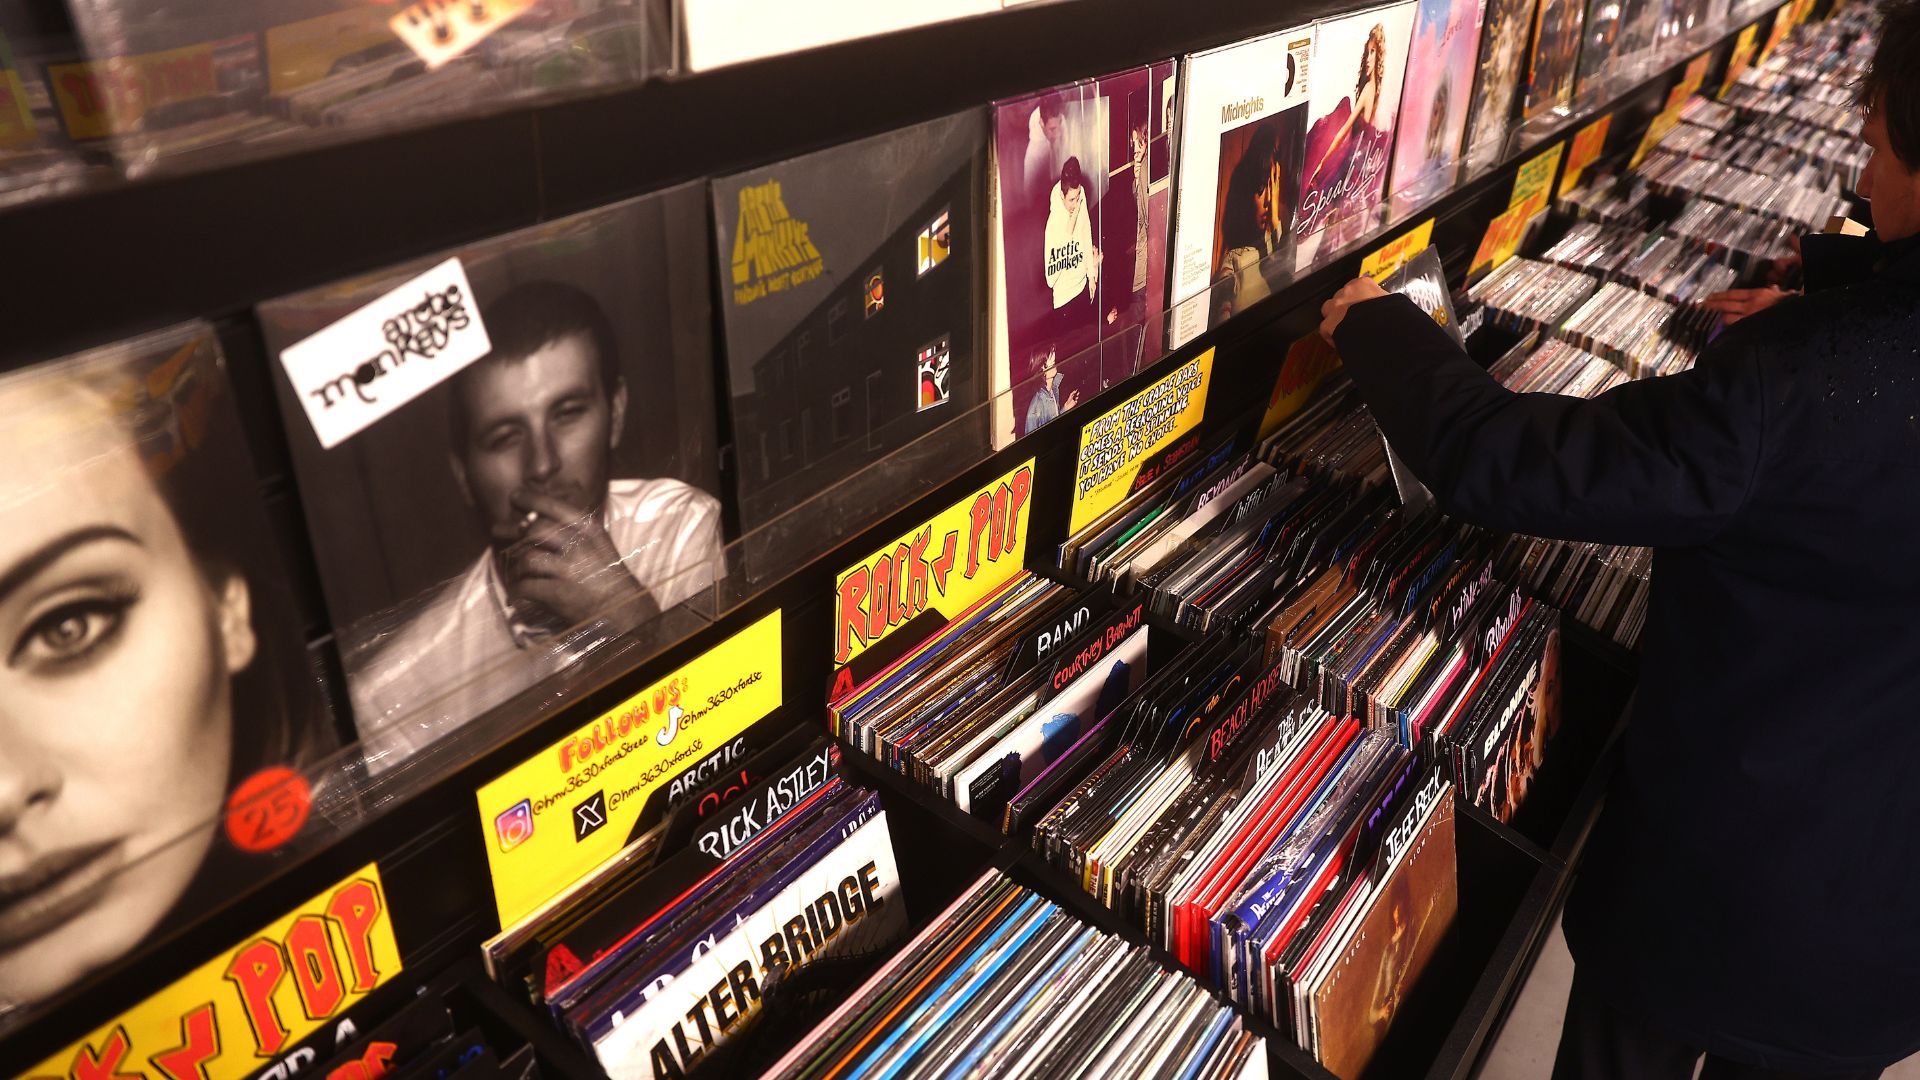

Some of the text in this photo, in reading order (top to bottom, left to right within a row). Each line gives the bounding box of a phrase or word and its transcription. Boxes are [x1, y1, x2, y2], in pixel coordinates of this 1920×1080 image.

[1221, 96, 1264, 124] Midnights
[1296, 130, 1364, 234] Speak
[1047, 251, 1084, 277] monkeys
[1049, 240, 1080, 264] Arctic
[1081, 372, 1203, 461] COMES A BECKONING VOICE
[1122, 394, 1144, 423] THE
[1143, 373, 1176, 408] CRADLE
[1174, 360, 1200, 388] BARS
[1079, 460, 1092, 480] IT
[1091, 438, 1124, 472] SENDS
[1127, 430, 1144, 449] YOU
[1079, 474, 1100, 501] YOU
[1098, 451, 1127, 485] HAVE
[1130, 441, 1144, 462] NO
[1197, 453, 1250, 511] BEYONCÉ
[835, 466, 1031, 665] ROCK POP
[1036, 606, 1090, 662] BAND
[1211, 697, 1249, 762] BEACH
[1249, 661, 1281, 718] HOUSE
[1483, 659, 1537, 761] BLONDIE
[668, 737, 746, 804] ARCTIC
[697, 798, 761, 860] RICK
[766, 746, 829, 824] ASTLEY
[243, 788, 300, 847] 25
[1385, 804, 1416, 867] JEFF
[1415, 765, 1441, 823] BECK
[223, 876, 382, 1058] POP
[649, 959, 762, 1080] ALTER
[759, 860, 885, 974] BRIDGE
